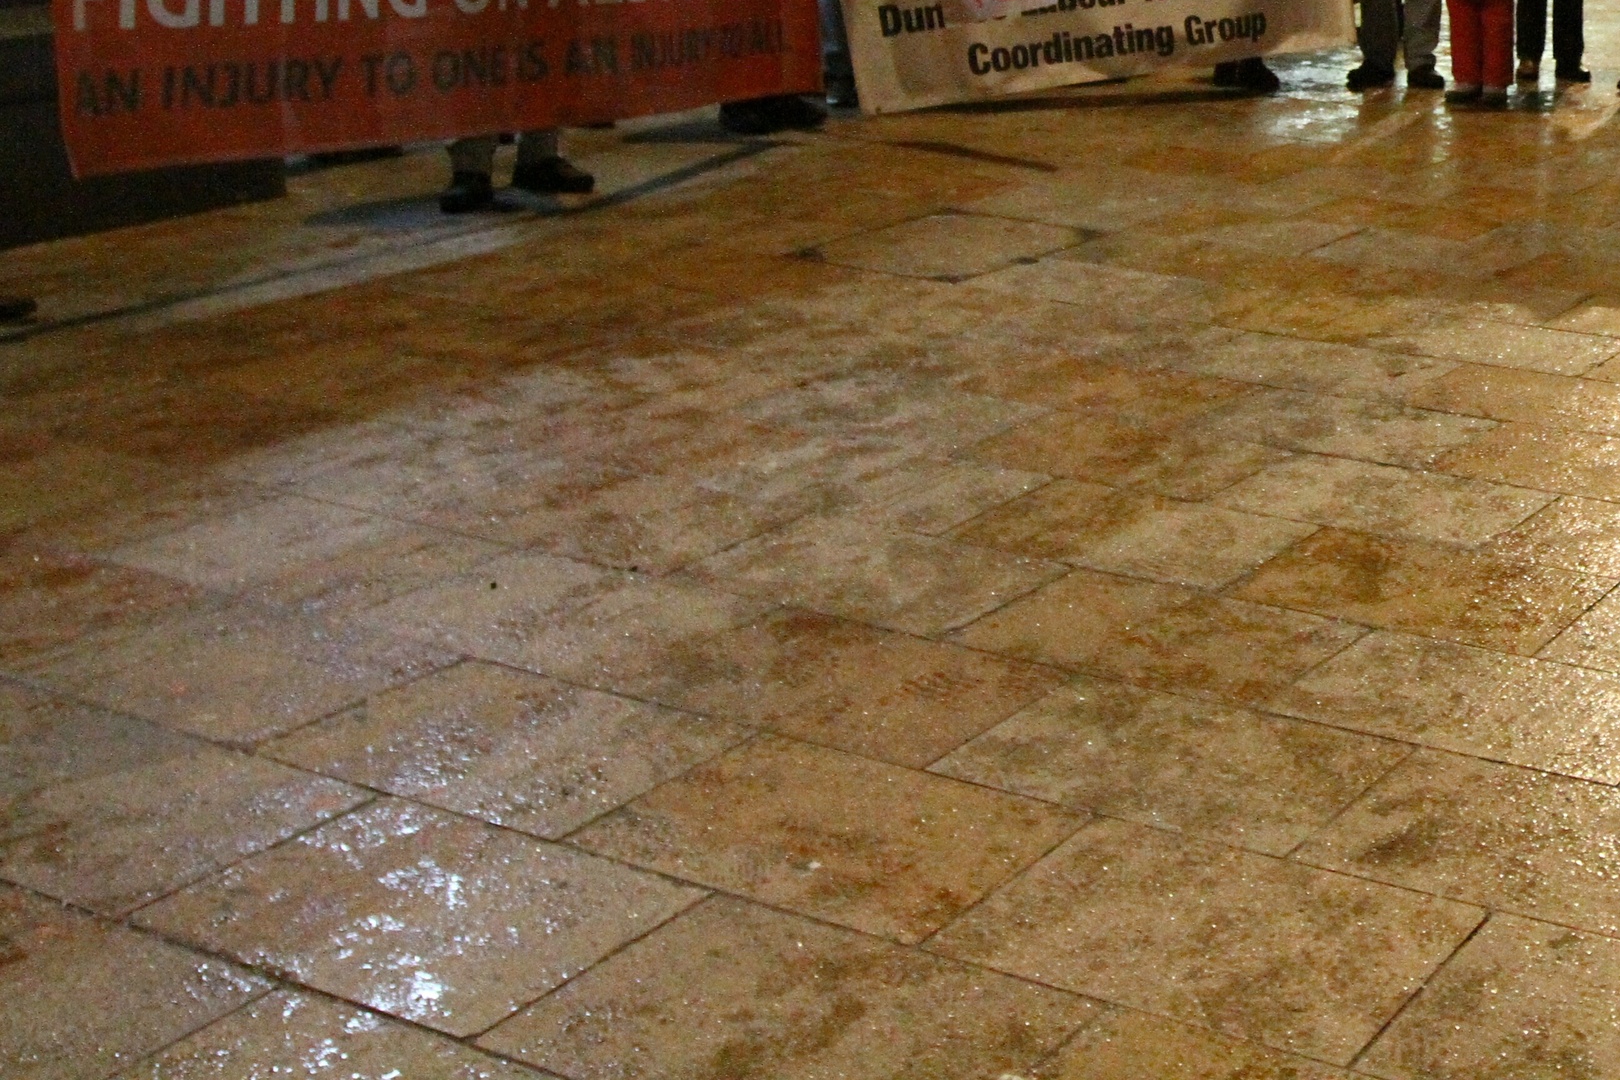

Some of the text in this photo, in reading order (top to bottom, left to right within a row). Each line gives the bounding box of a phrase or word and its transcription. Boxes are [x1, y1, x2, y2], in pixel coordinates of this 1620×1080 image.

[878, 3, 945, 37] Dun
[967, 9, 1267, 77] Coordinating Group
[74, 68, 140, 117] AN
[162, 55, 344, 109] INJURY
[360, 48, 417, 96] TO
[432, 41, 506, 94] ONE
[516, 37, 548, 82] IS
[561, 32, 618, 78] AN
